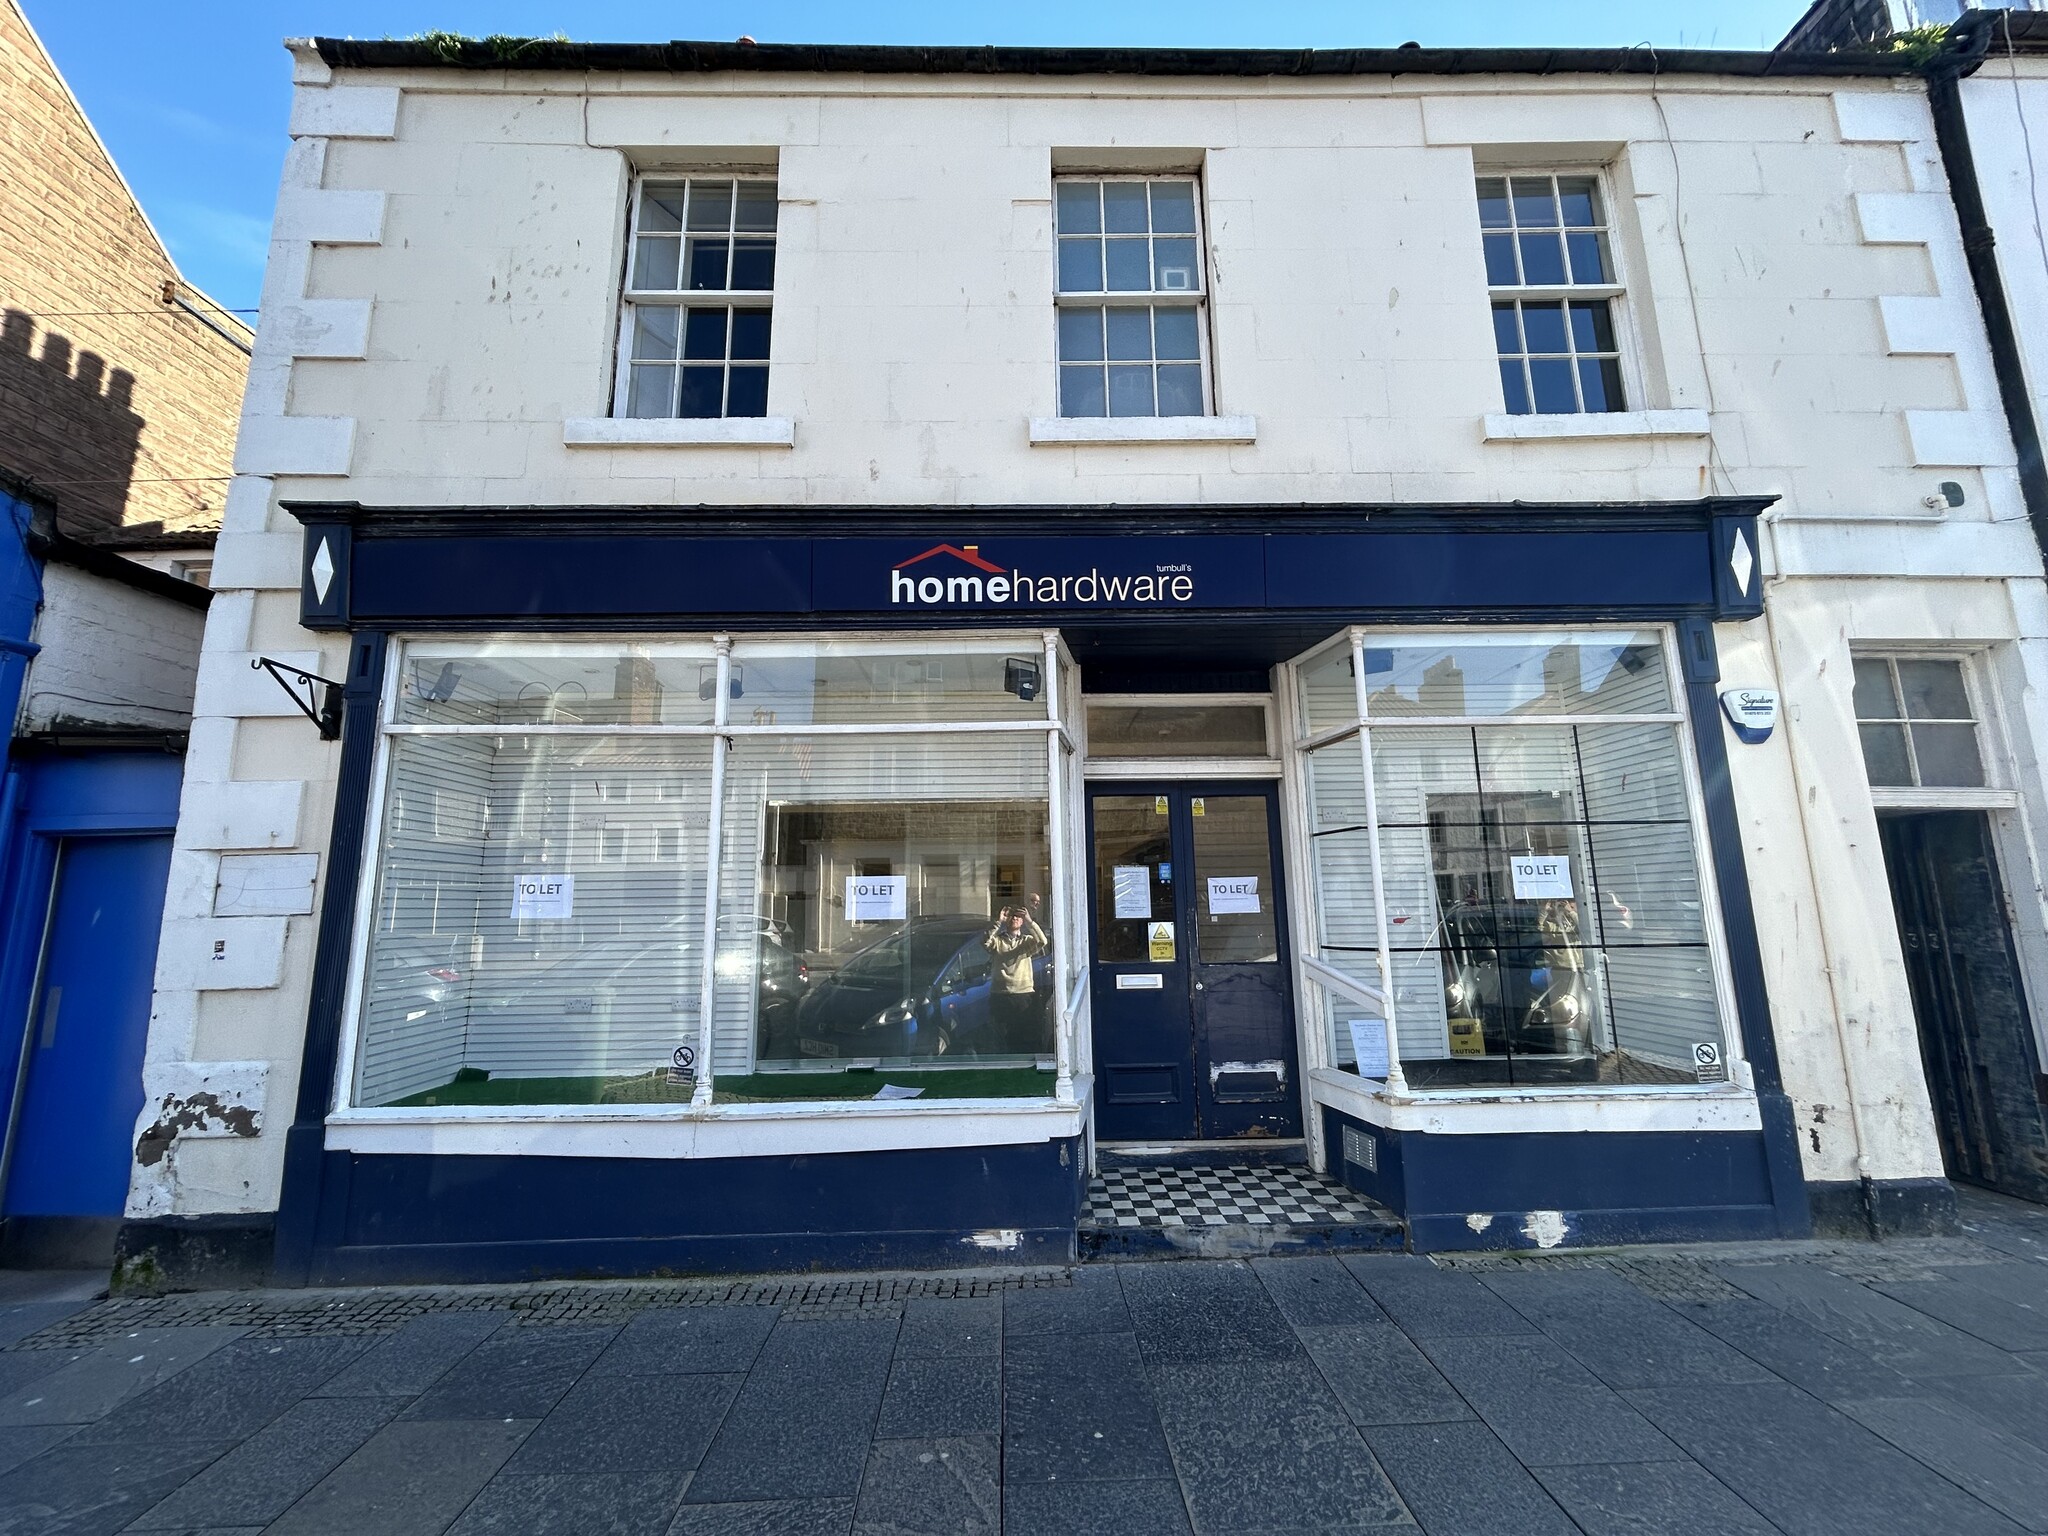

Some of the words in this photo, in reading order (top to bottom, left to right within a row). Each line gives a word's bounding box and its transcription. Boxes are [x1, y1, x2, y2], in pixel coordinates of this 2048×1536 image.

[1156, 563, 1192, 572] turnbull's
[1738, 693, 1773, 706] Signature
[1516, 865, 1534, 875] TO
[1536, 865, 1557, 875] LET
[519, 884, 536, 894] TO
[539, 884, 562, 894] LET
[851, 885, 869, 895] TO
[872, 885, 894, 895] LET
[1212, 884, 1227, 894] TO
[1229, 884, 1248, 894] LET
